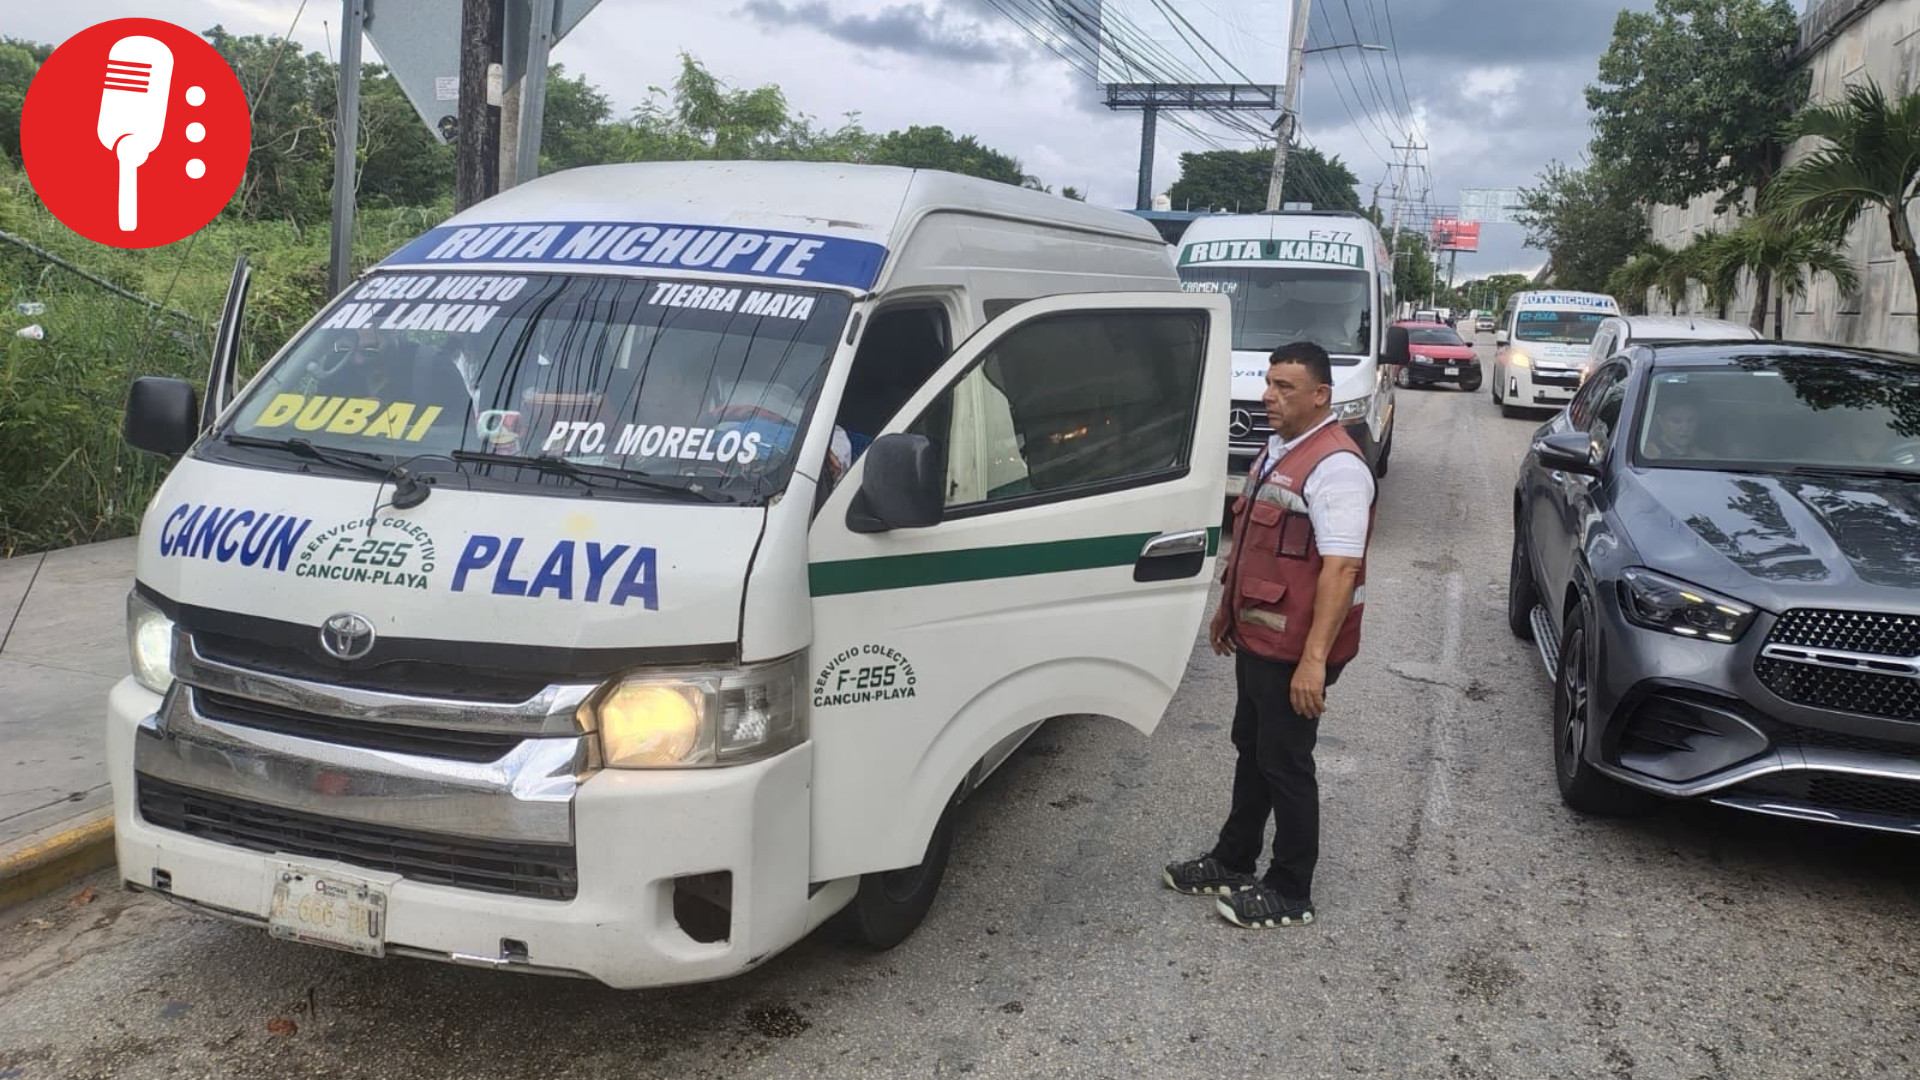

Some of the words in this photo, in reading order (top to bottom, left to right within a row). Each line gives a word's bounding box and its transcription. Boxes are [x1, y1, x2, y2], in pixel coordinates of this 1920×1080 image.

[425, 225, 549, 260] RUTA
[555, 225, 825, 275] NICHUPTE
[1189, 240, 1262, 262] RUTA
[1278, 240, 1358, 266] KABAH
[354, 276, 437, 300] CIELO
[426, 275, 528, 301] NUEVO
[648, 283, 742, 312] TIERRA
[738, 290, 817, 320] MAYA
[321, 303, 385, 329] AV.
[379, 303, 500, 333] LAKIN
[255, 394, 444, 441] DUBAI
[542, 420, 606, 454] PTO.
[615, 424, 761, 464] MORELOS
[160, 503, 312, 571] CANCUN
[300, 517, 377, 562] SERVICIO
[382, 517, 436, 573] COLECTIVO
[328, 537, 414, 568] F-255
[296, 563, 428, 590] CANCUN-PLAYA
[451, 535, 659, 611] PLAYA
[814, 647, 859, 695] SERVICIO
[863, 644, 917, 686] COLECTIVO
[837, 665, 897, 691] F-255
[814, 687, 916, 708] CANCUN-PLAYA
